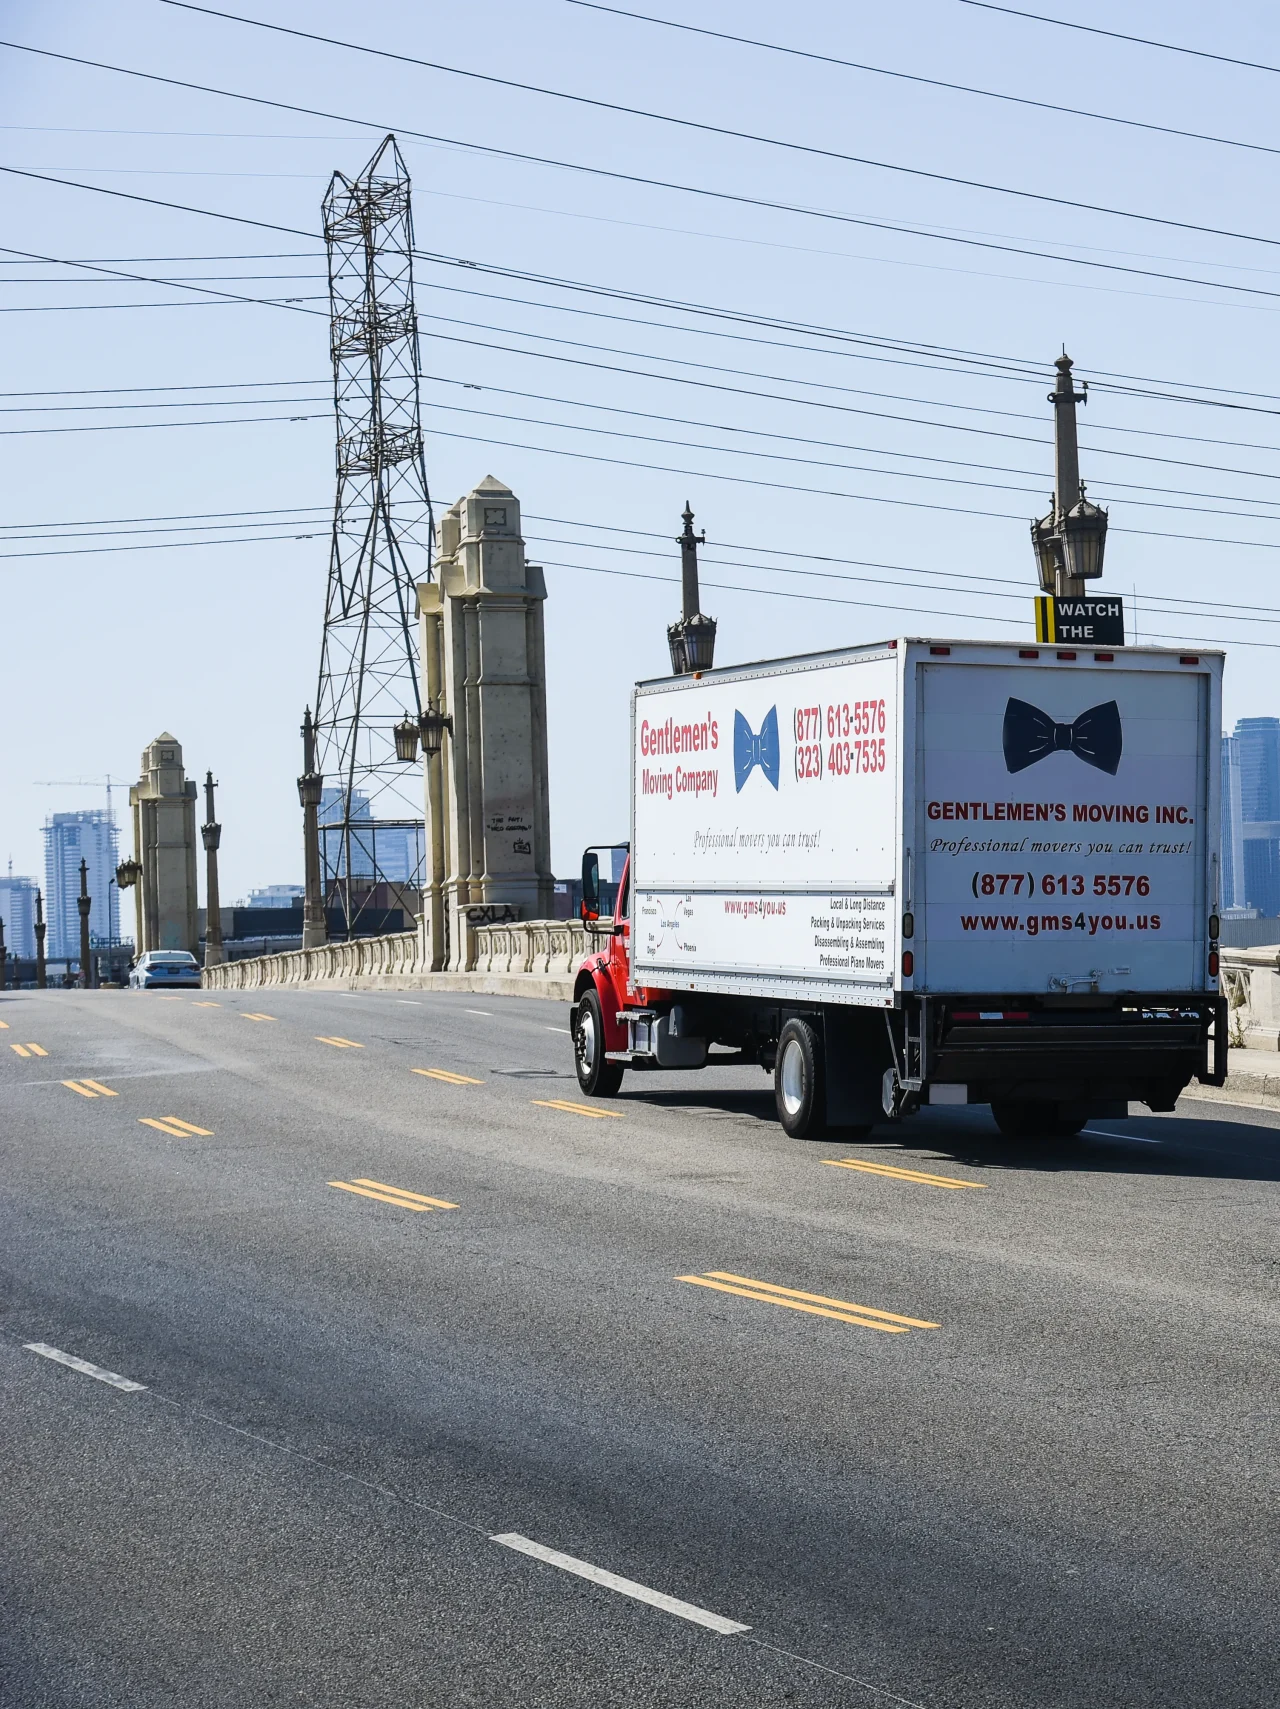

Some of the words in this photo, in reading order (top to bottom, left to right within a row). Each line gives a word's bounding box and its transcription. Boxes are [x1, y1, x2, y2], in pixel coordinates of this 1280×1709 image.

[1058, 603, 1119, 617] WATCH
[1059, 625, 1094, 638] THE
[793, 704, 822, 745] (877)
[827, 699, 886, 738] 613-5576
[640, 711, 719, 757] Gentlemen's
[794, 743, 823, 783] (323)
[828, 738, 886, 776] 403-7535
[642, 767, 673, 800] Moving
[675, 765, 719, 799] Company
[927, 801, 1067, 822] GENTLEMEN'S
[1072, 804, 1149, 824] MOVING
[1155, 806, 1194, 825] INC.
[693, 826, 739, 854] Professional
[739, 833, 765, 848] movers
[764, 833, 781, 854] you
[782, 833, 796, 848] can
[797, 829, 821, 848] trust!
[930, 836, 1030, 857] Professional
[1030, 840, 1083, 853] movers
[1084, 843, 1114, 857] you
[1118, 843, 1144, 854] can
[1149, 841, 1193, 854] trust!
[971, 871, 1035, 899] (877)
[1041, 874, 1085, 896] 613
[1092, 875, 1151, 897] 5576
[724, 898, 787, 920] www.gms4you.us
[830, 897, 844, 910] Local
[849, 898, 862, 913] Long
[862, 898, 886, 911] Distance
[810, 916, 831, 932] Packing
[836, 917, 862, 933] Unpacking
[862, 917, 886, 931] Services
[960, 911, 1162, 936] www.gms4you.us
[814, 934, 849, 952] Disassembling
[855, 936, 885, 954] Assembling
[819, 953, 850, 968] Professional
[850, 955, 866, 969] Piano
[866, 956, 885, 970] Movers
